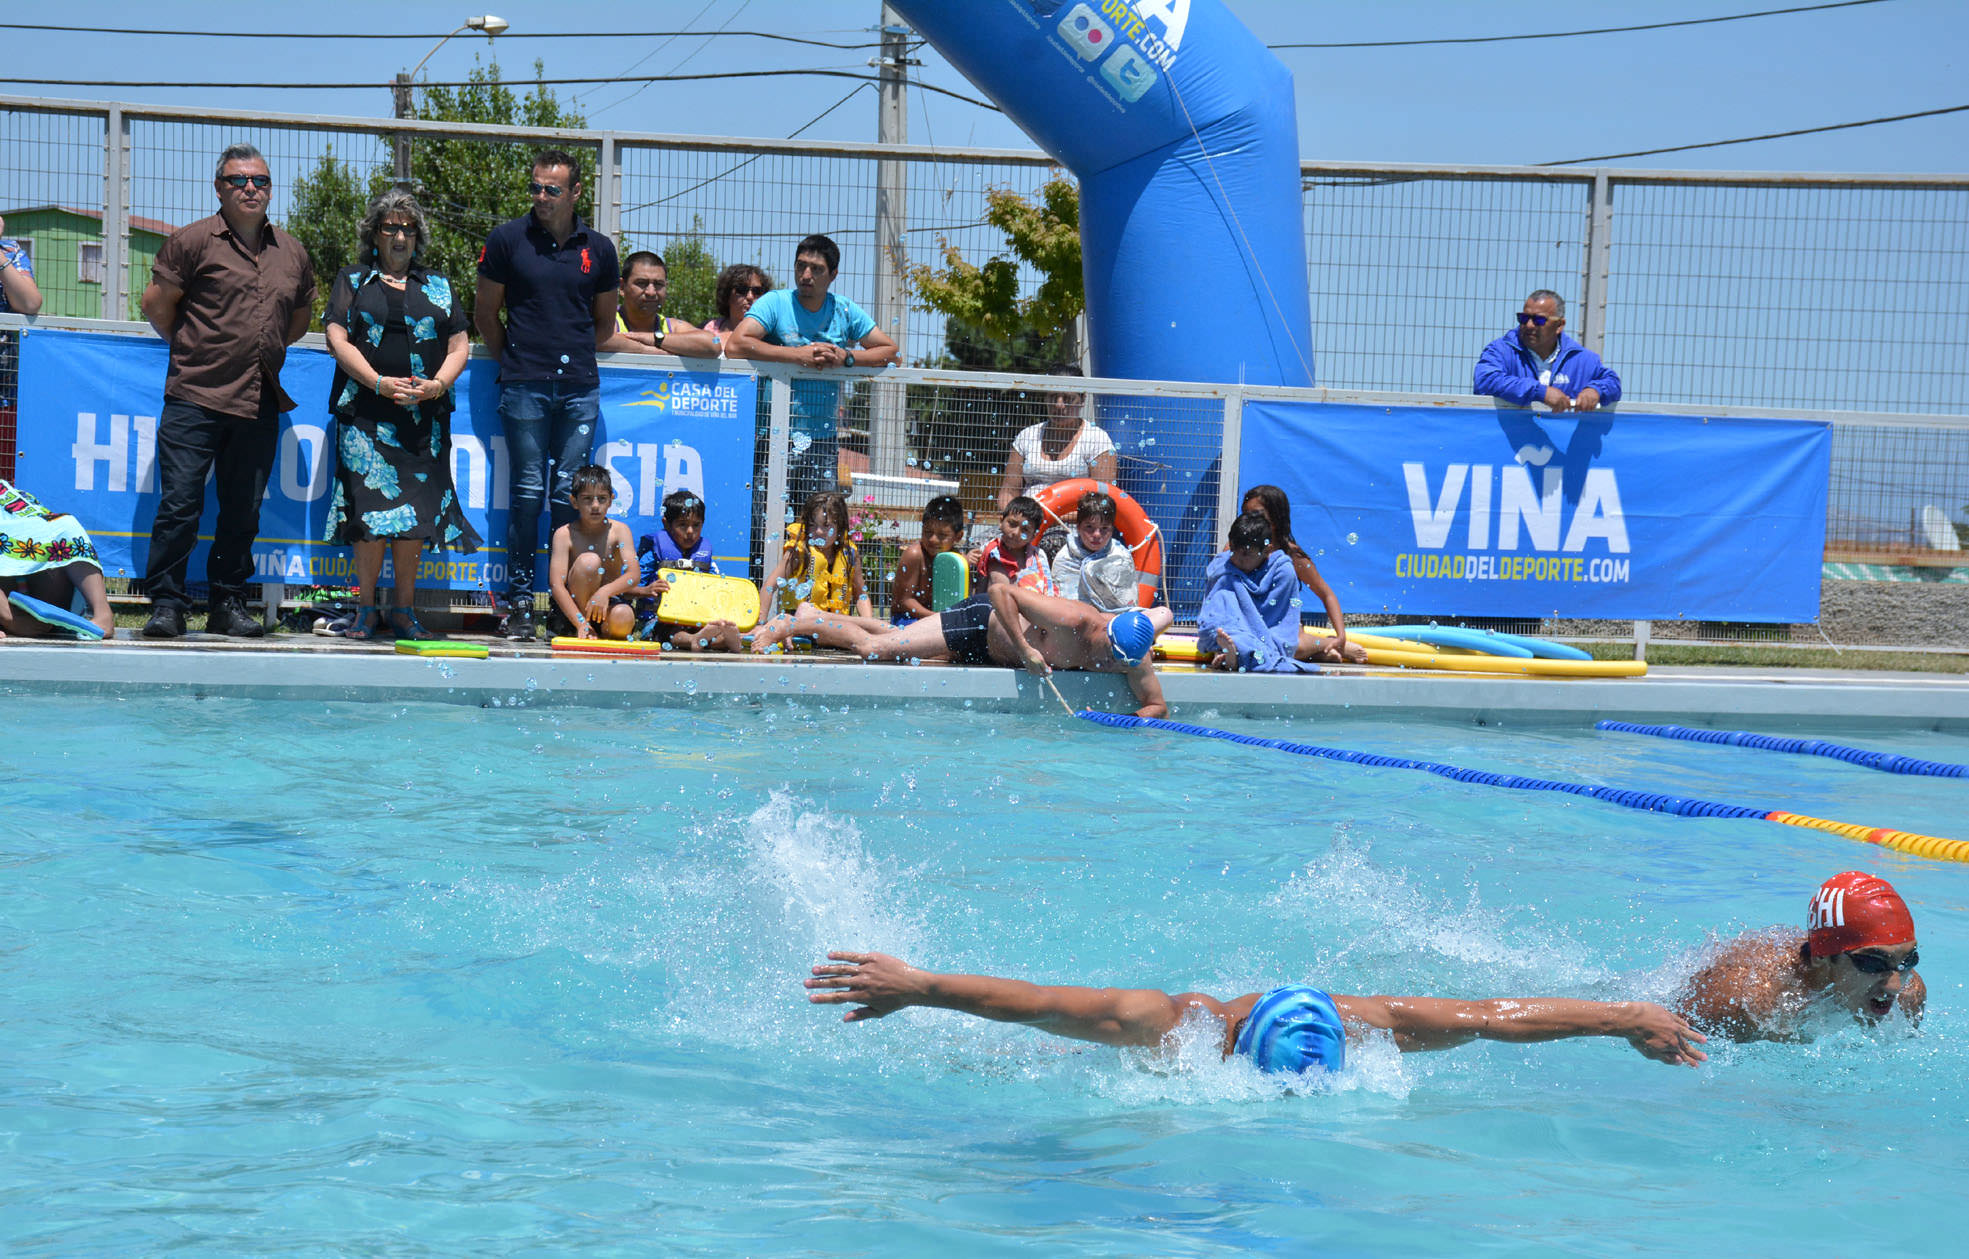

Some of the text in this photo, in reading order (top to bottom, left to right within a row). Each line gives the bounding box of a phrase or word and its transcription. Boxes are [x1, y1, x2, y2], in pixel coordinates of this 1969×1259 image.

[671, 382, 738, 398] CASA DEL
[671, 396, 738, 412] DEPORTE
[1402, 444, 1631, 554] VIÑA
[1396, 553, 1630, 583] CIUDADDELDEPORTE.COM
